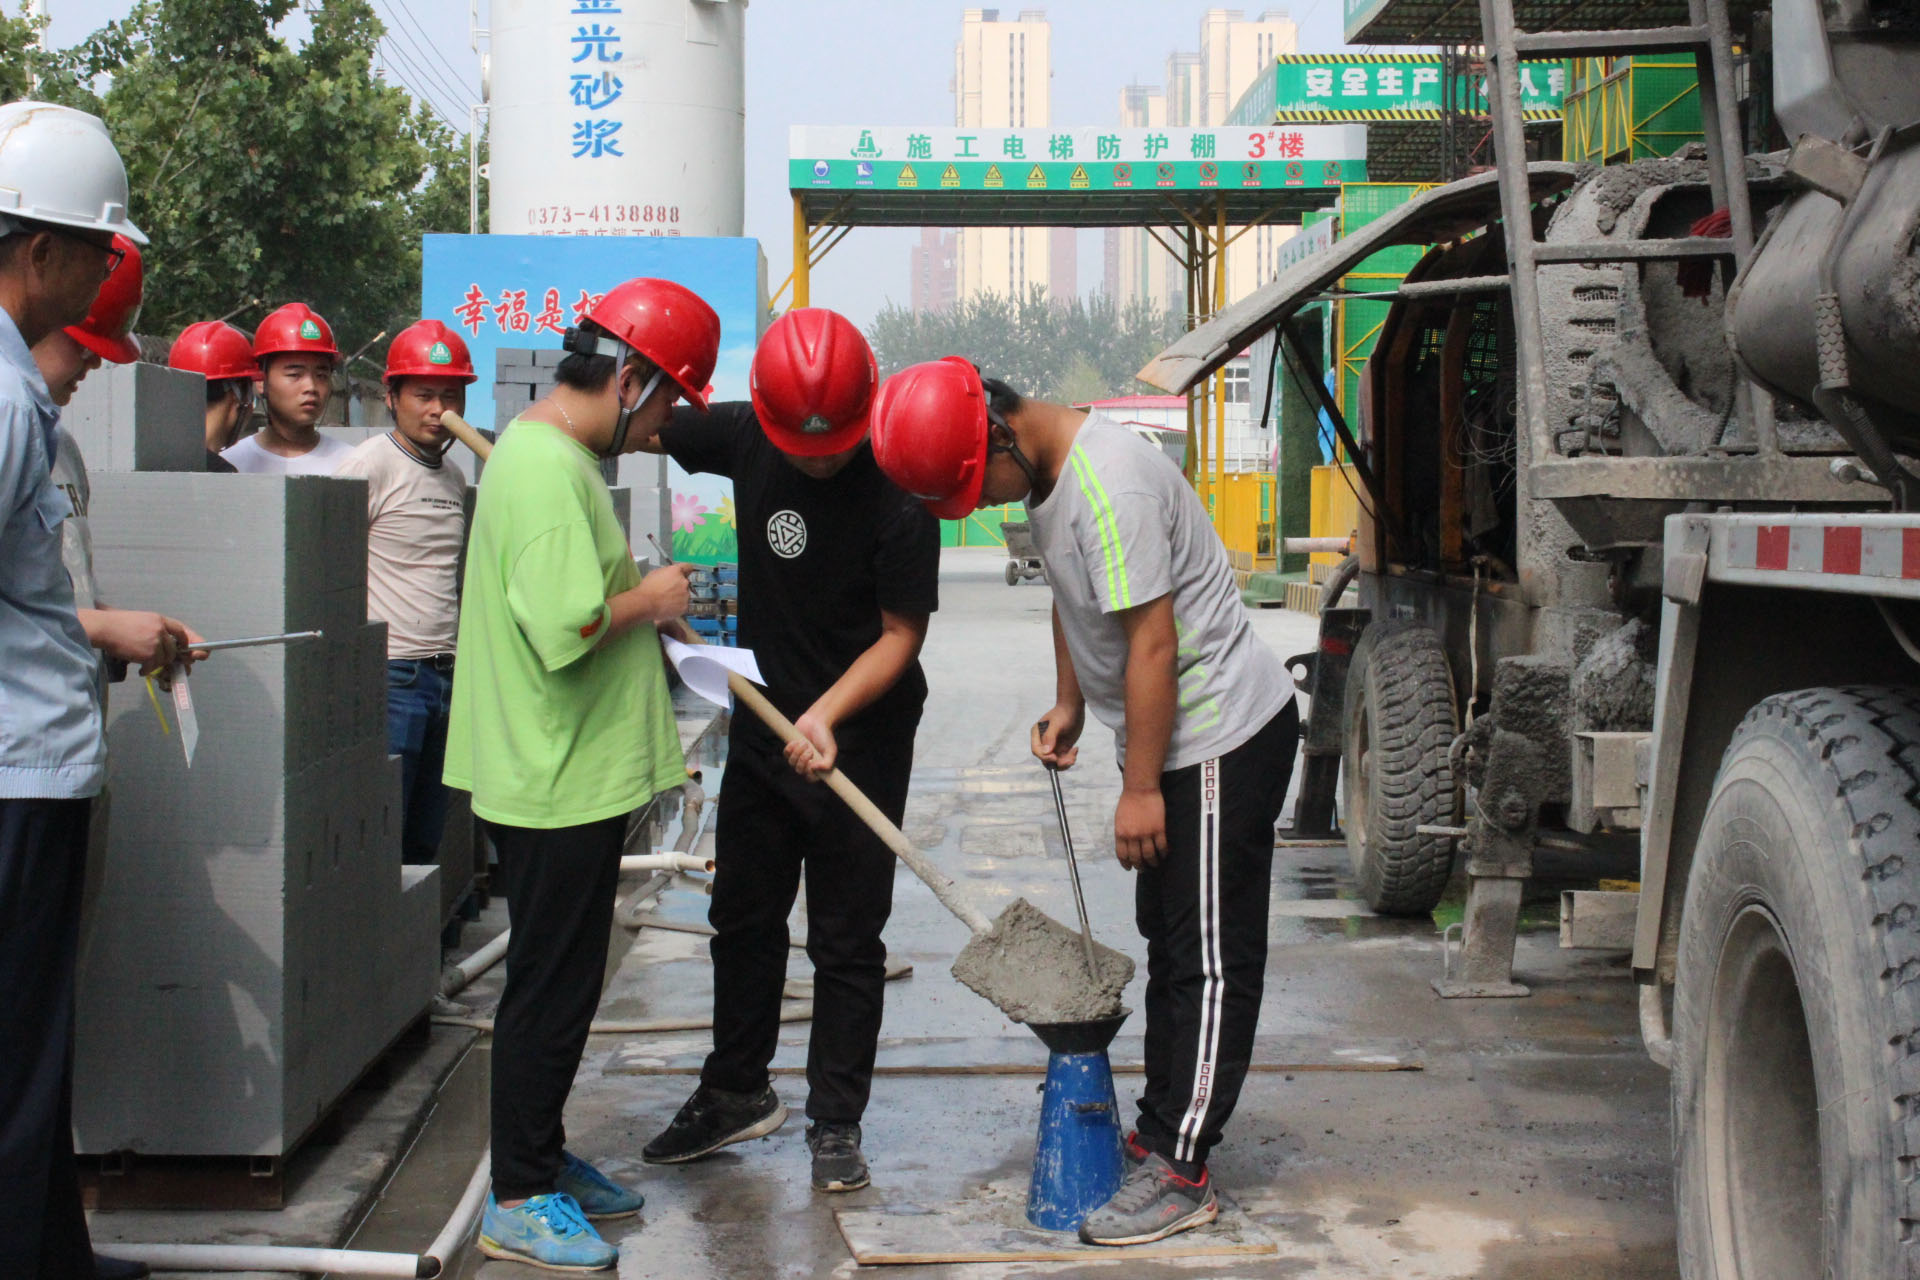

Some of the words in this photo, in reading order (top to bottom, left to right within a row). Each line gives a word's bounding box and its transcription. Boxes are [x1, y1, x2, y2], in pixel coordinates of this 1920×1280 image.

[1305, 67, 1440, 97] 安全生产
[906, 134, 1216, 160] 施工电梯防护棚
[528, 204, 680, 225] 0373-4138888
